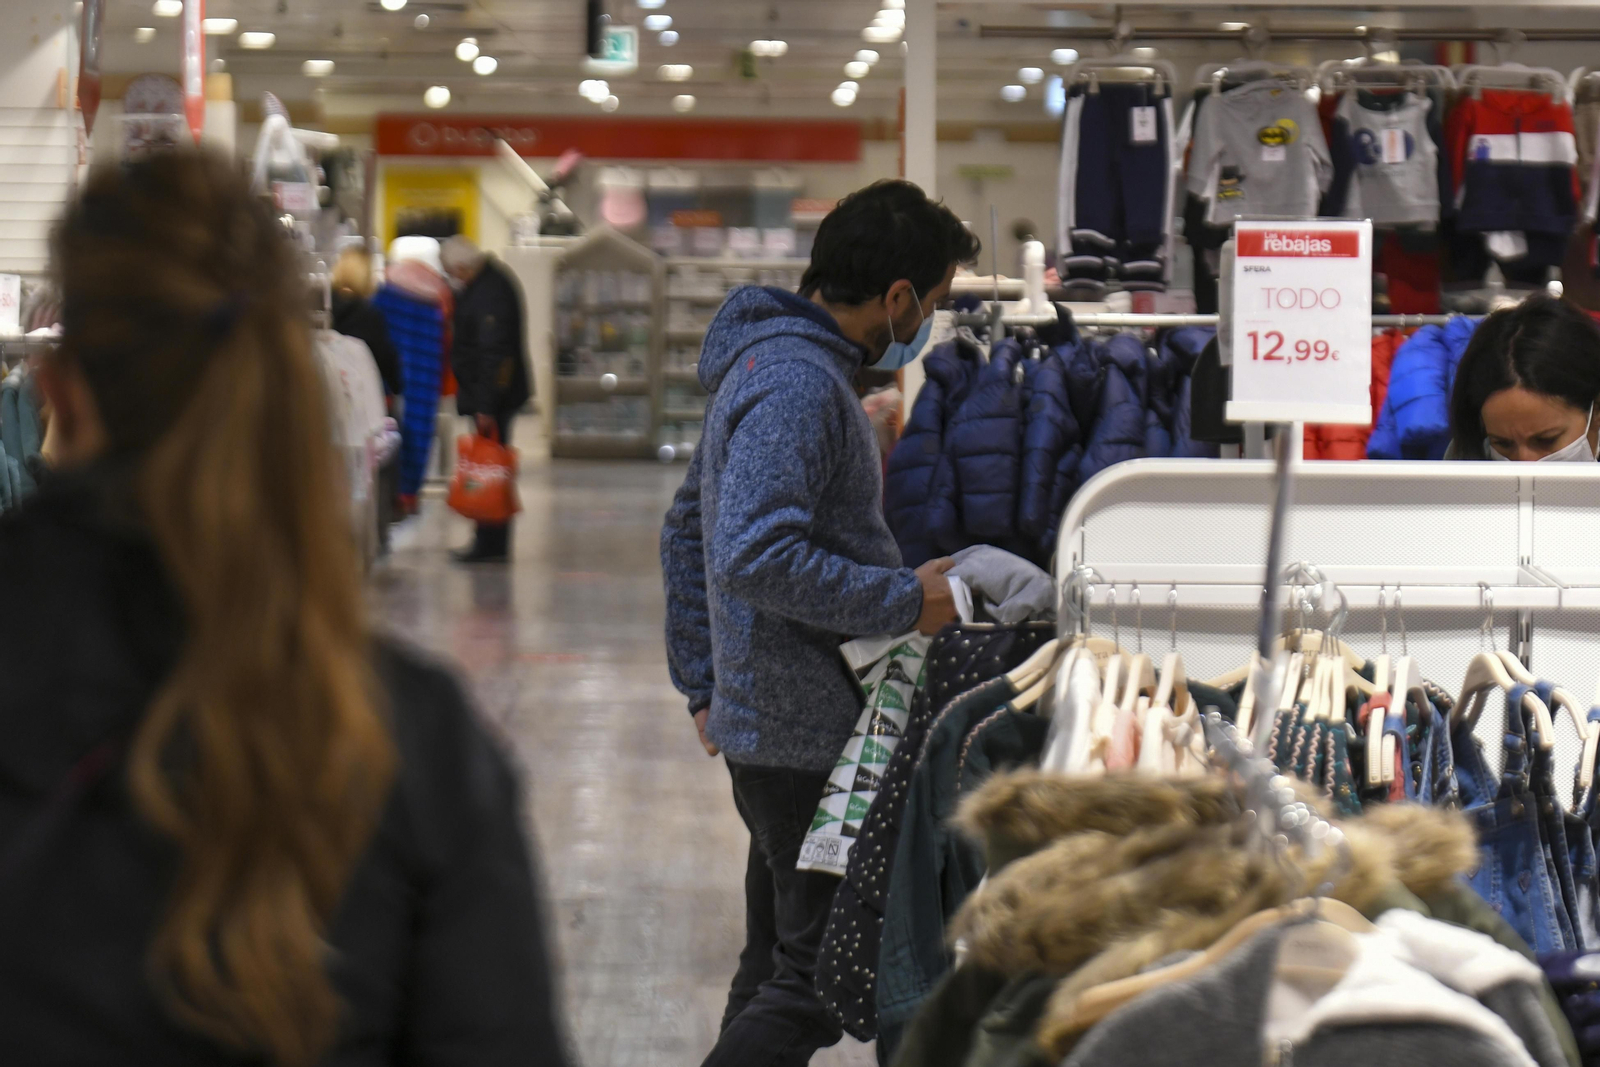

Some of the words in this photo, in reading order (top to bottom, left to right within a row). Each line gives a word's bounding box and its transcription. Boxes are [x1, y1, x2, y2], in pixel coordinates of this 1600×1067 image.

[1264, 231, 1278, 239] Las
[1264, 235, 1331, 255] rebajas
[1261, 287, 1341, 309] TODO
[1247, 330, 1339, 364] 12,99€
